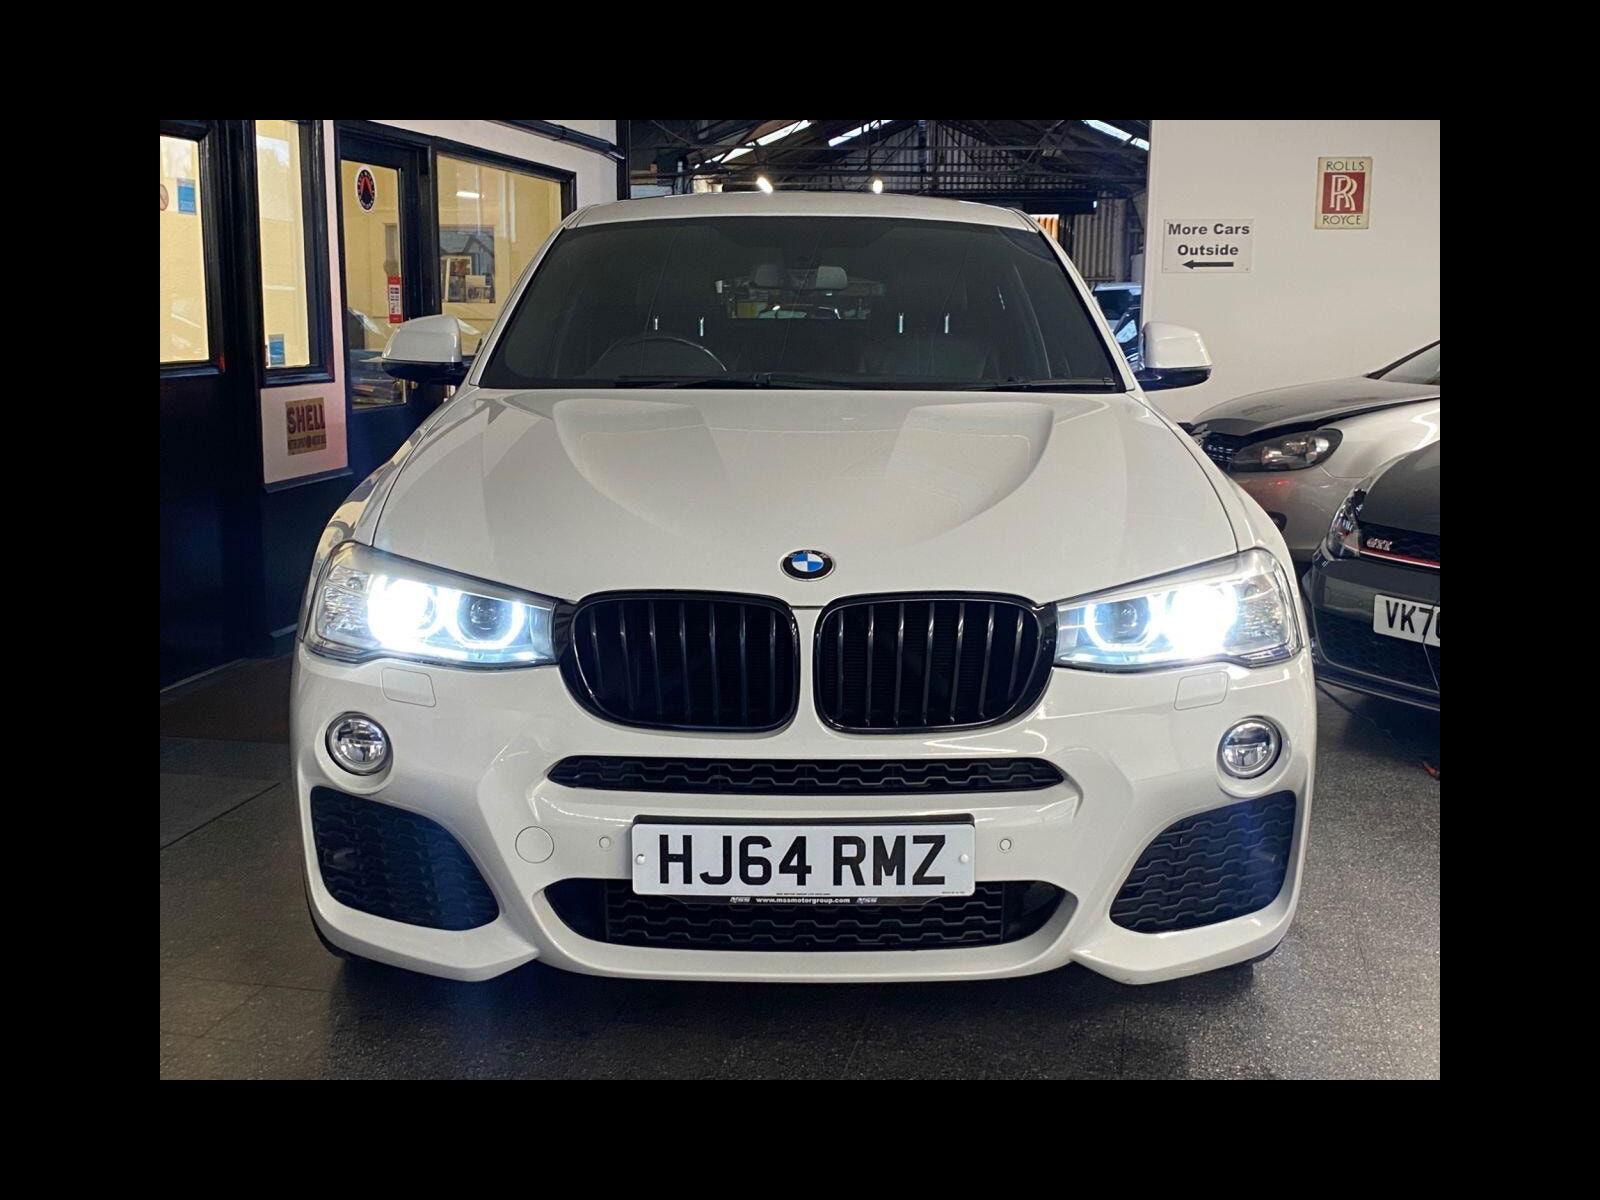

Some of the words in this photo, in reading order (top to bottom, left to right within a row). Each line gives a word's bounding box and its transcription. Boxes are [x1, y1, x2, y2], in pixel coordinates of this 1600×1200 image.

[1326, 160, 1365, 171] ROLLS
[1322, 214, 1361, 225] ROYCE
[1167, 223, 1208, 236] More
[1213, 223, 1250, 236] Cars
[1177, 244, 1239, 256] Outside
[286, 404, 326, 434] SHELL
[659, 834, 812, 887] HJ64
[832, 834, 946, 887] RMZ
[755, 896, 850, 905] www.mssmotorgroup.com
